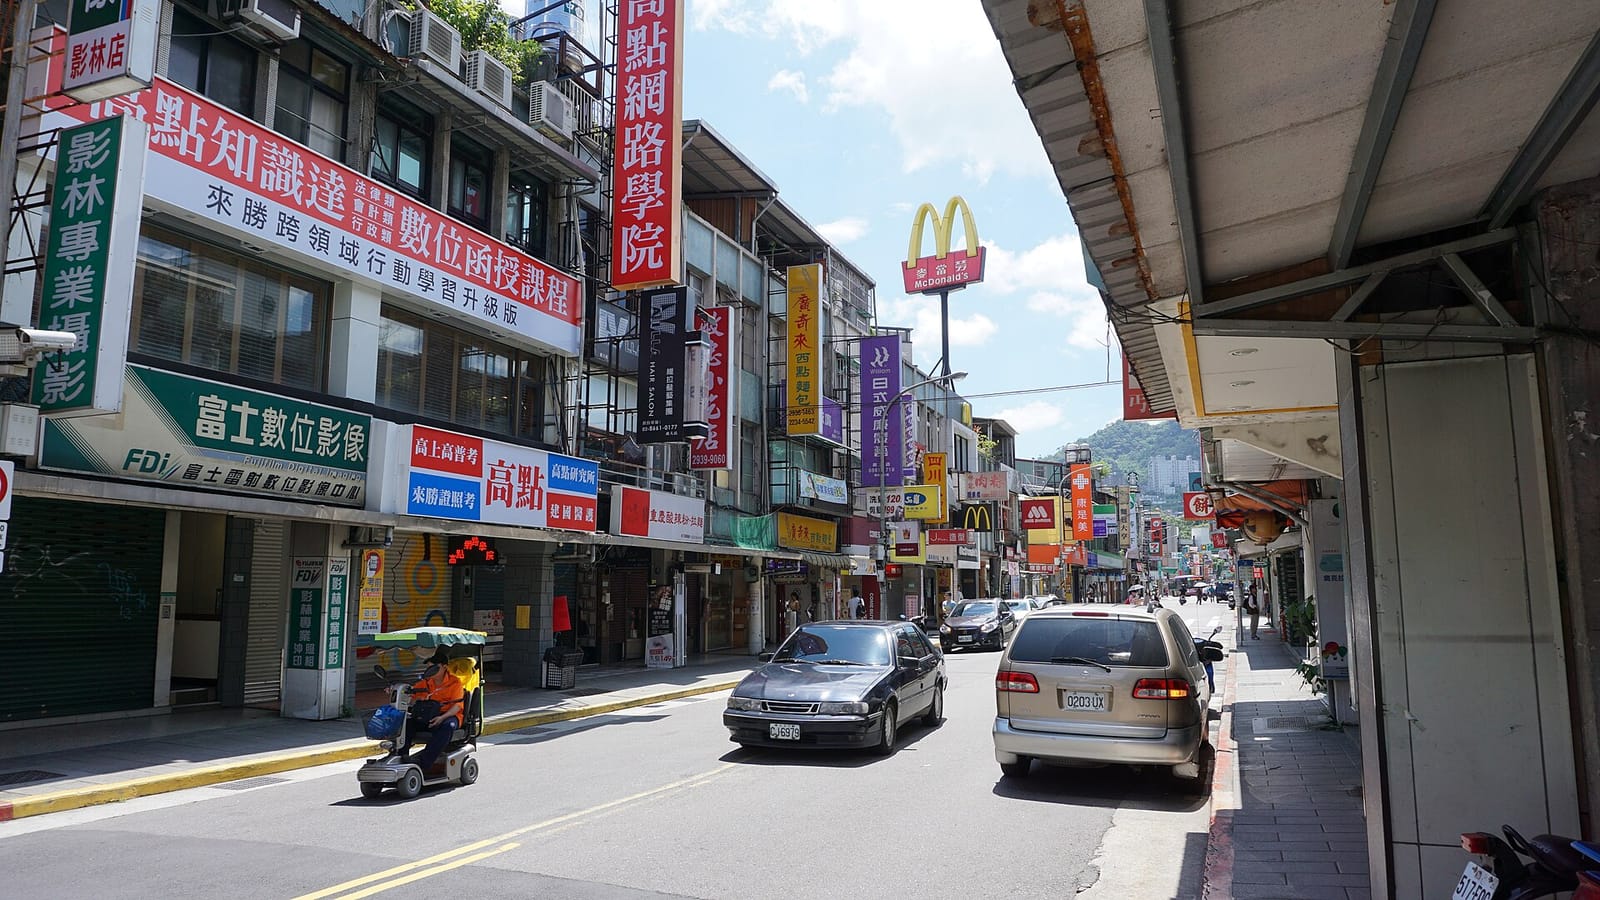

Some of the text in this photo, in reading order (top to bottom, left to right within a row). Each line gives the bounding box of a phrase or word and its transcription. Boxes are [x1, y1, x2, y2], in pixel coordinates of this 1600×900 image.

[70, 33, 126, 80] 影林店
[355, 179, 395, 208] 法律類
[353, 198, 394, 226] 會計類
[352, 217, 392, 245] 行政類
[207, 184, 518, 326] 來勝跨領域行動學習升級版
[398, 206, 568, 316] 數位函授課程
[915, 272, 968, 288] McDonald's
[917, 260, 967, 279] 麥當勞
[196, 394, 365, 463] 富士數位影像
[415, 438, 479, 466] 高上高普考
[692, 454, 726, 465] 2939-9060
[182, 464, 361, 500] 富士雷射數位影像中心
[552, 463, 595, 485] 高點研究所
[928, 456, 942, 481] 四川
[412, 485, 475, 511] 來勝證照考
[485, 459, 545, 511] 高點
[886, 494, 901, 503] 120
[1076, 498, 1088, 532] 康是美
[1193, 498, 1209, 514] 餅
